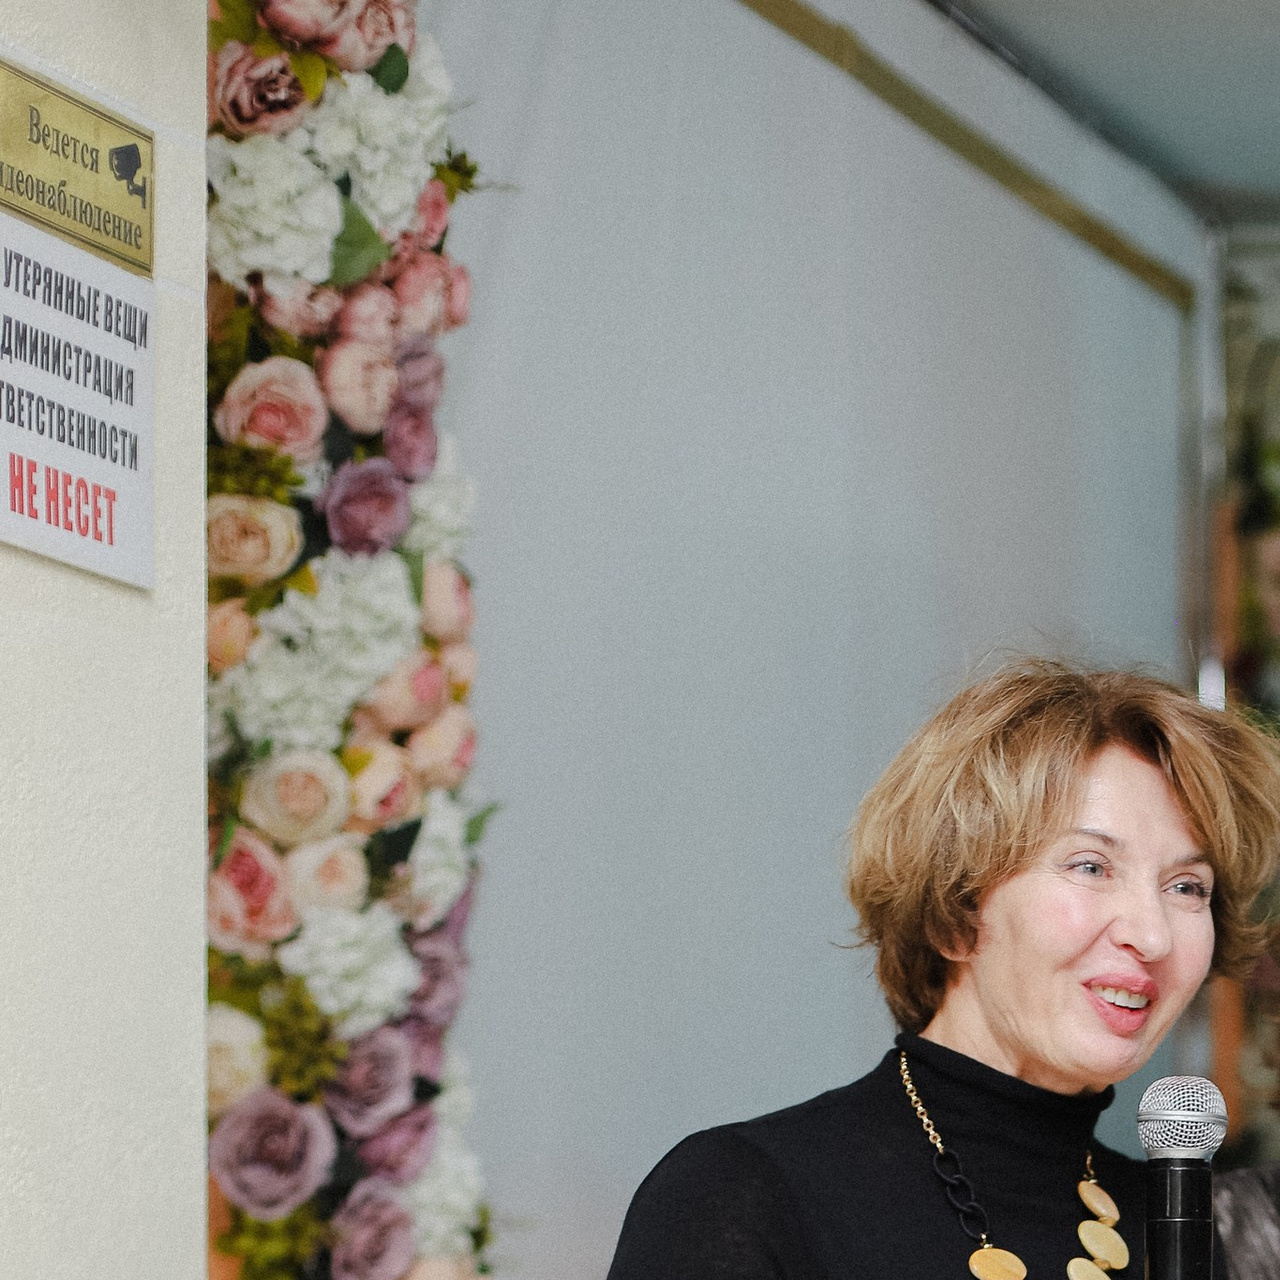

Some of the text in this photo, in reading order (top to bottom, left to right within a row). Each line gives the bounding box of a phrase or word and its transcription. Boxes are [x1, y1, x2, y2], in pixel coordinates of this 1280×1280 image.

[28, 104, 100, 174] Ведется
[3, 246, 148, 351] УТЕРЯННЫЕ ВЕЩИ
[9, 451, 117, 546] НЕ НЕСЕТ
